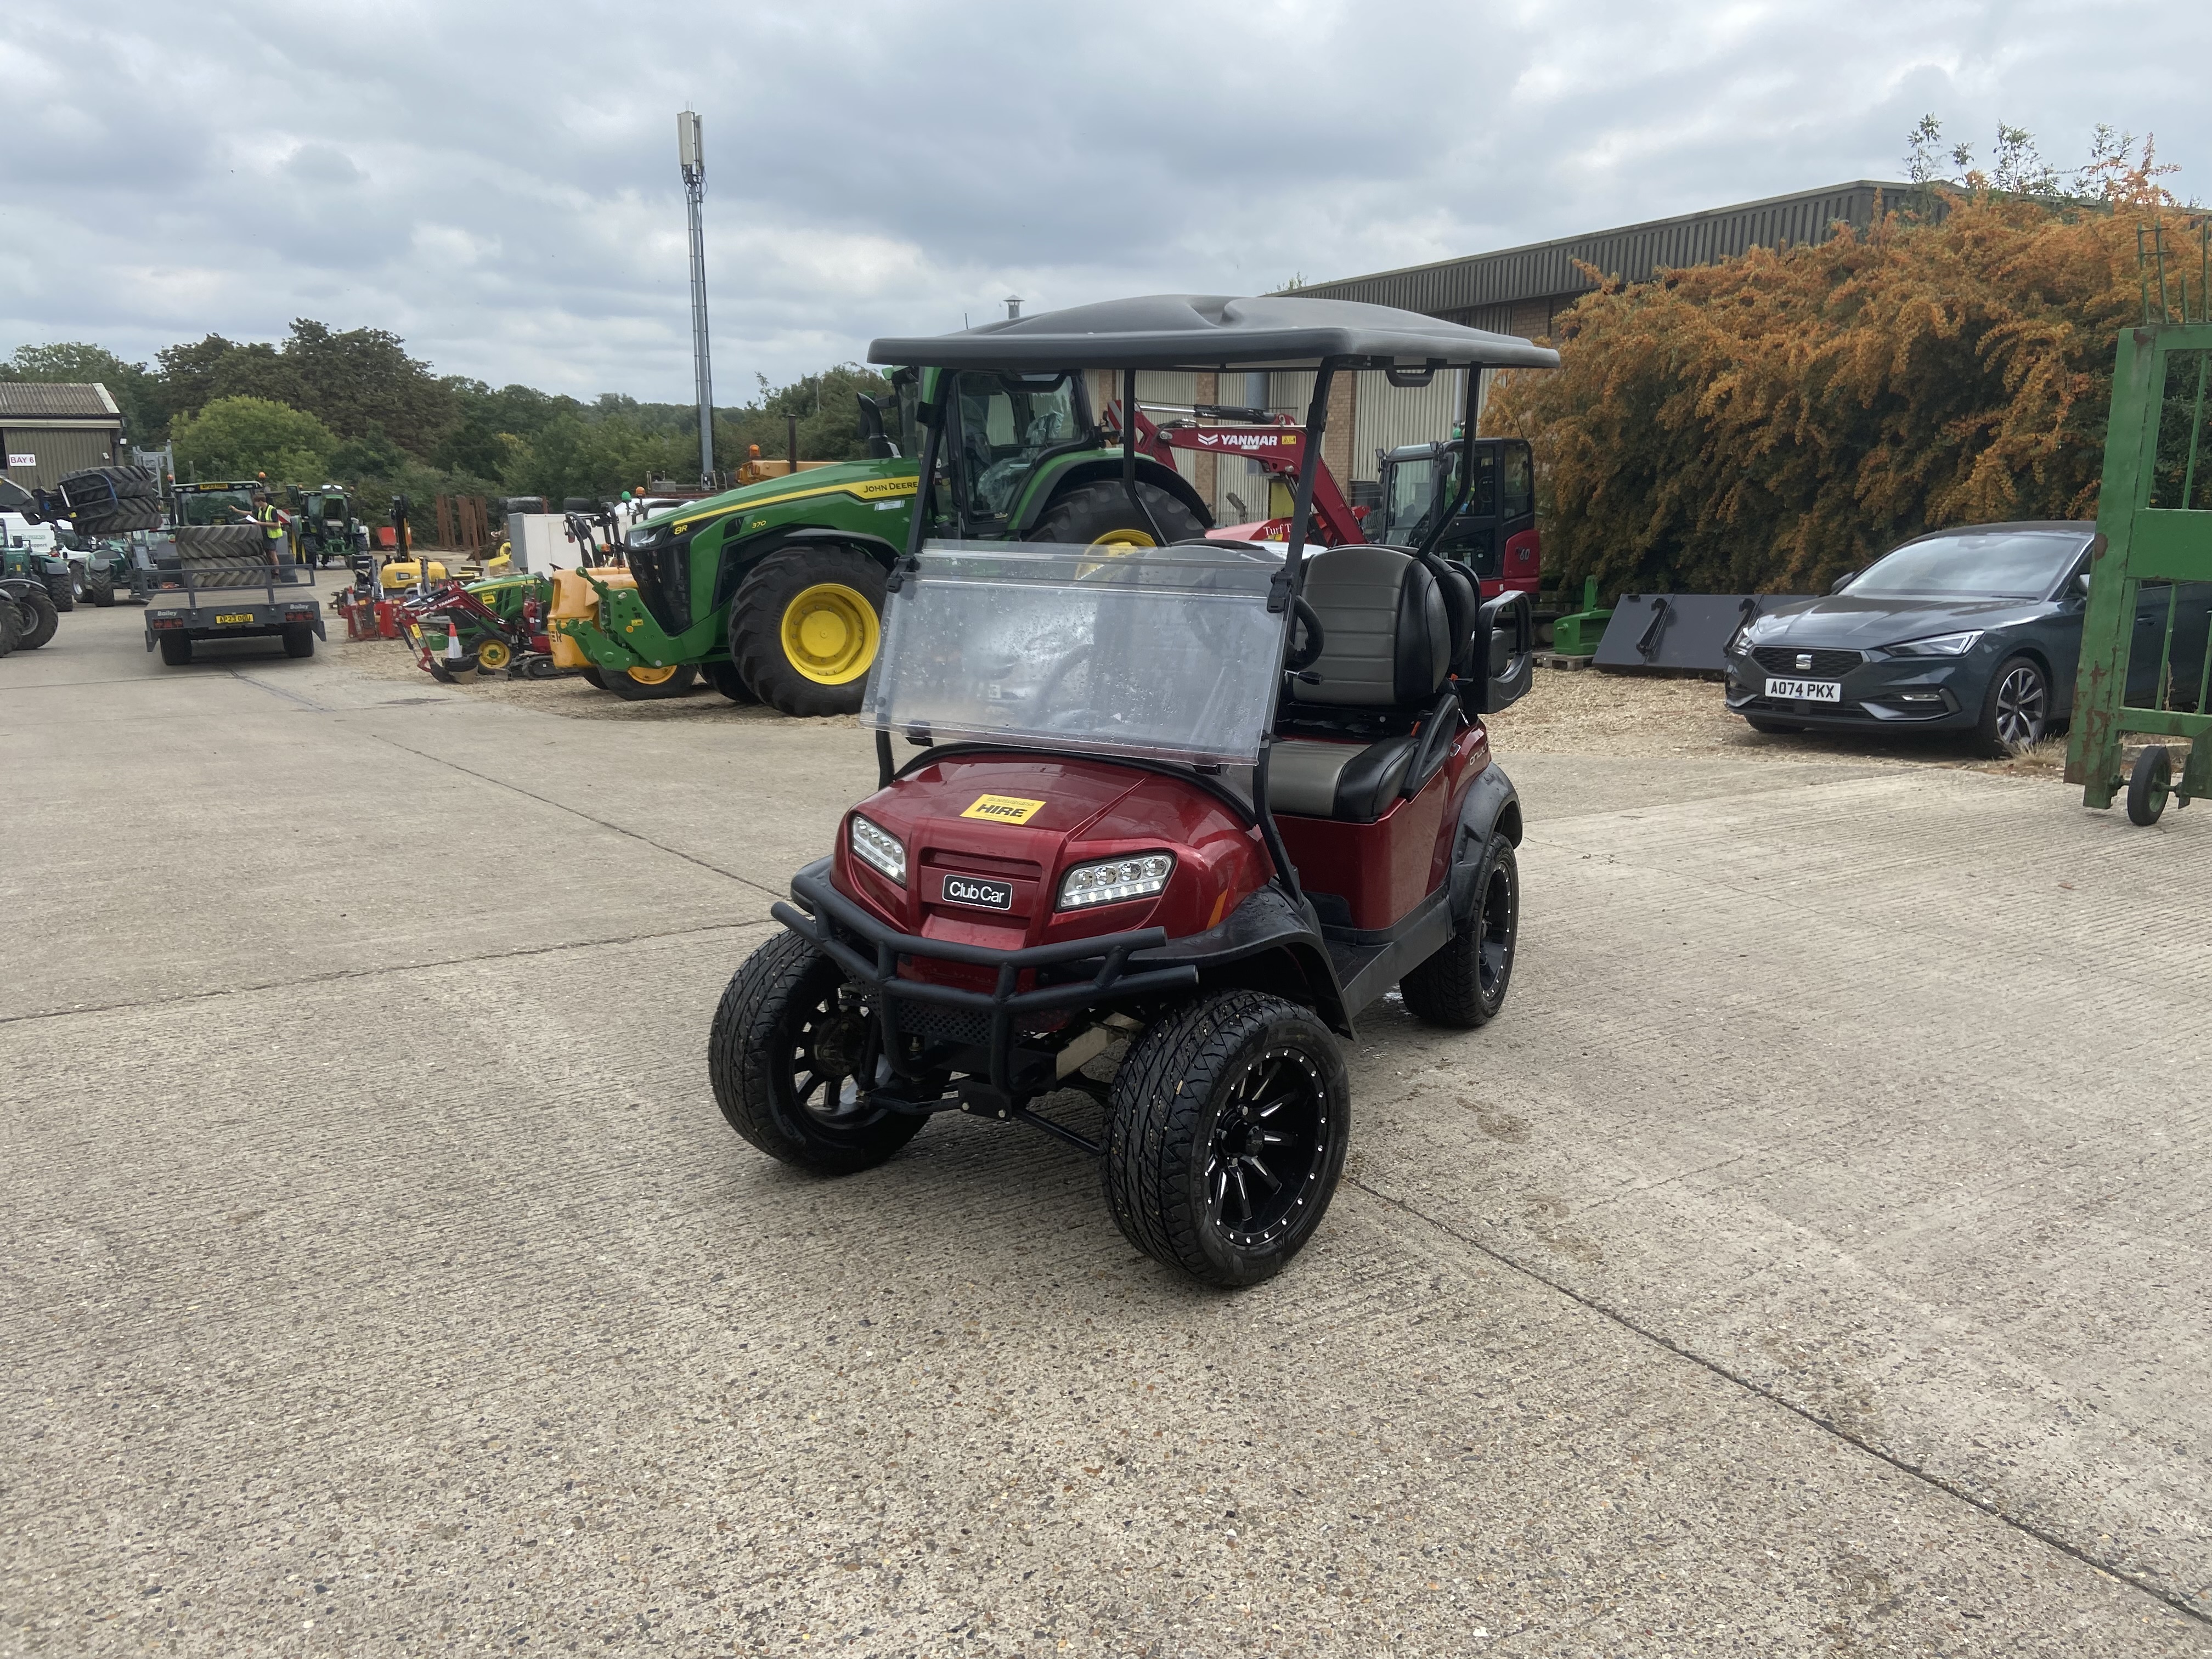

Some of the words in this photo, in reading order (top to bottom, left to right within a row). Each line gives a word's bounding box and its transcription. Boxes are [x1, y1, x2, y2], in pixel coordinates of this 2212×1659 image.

[1221, 435, 1278, 445] YANMAR
[864, 484, 888, 493] JOHN
[889, 482, 918, 490] DEERE
[674, 525, 688, 535] 8R
[752, 521, 766, 529] 370
[1263, 524, 1284, 536] Turf
[1770, 681, 1803, 696] AO74
[1807, 684, 1835, 698] PKX
[975, 804, 1028, 817] HIRE
[950, 881, 979, 899] Club
[980, 886, 1005, 903] Car
